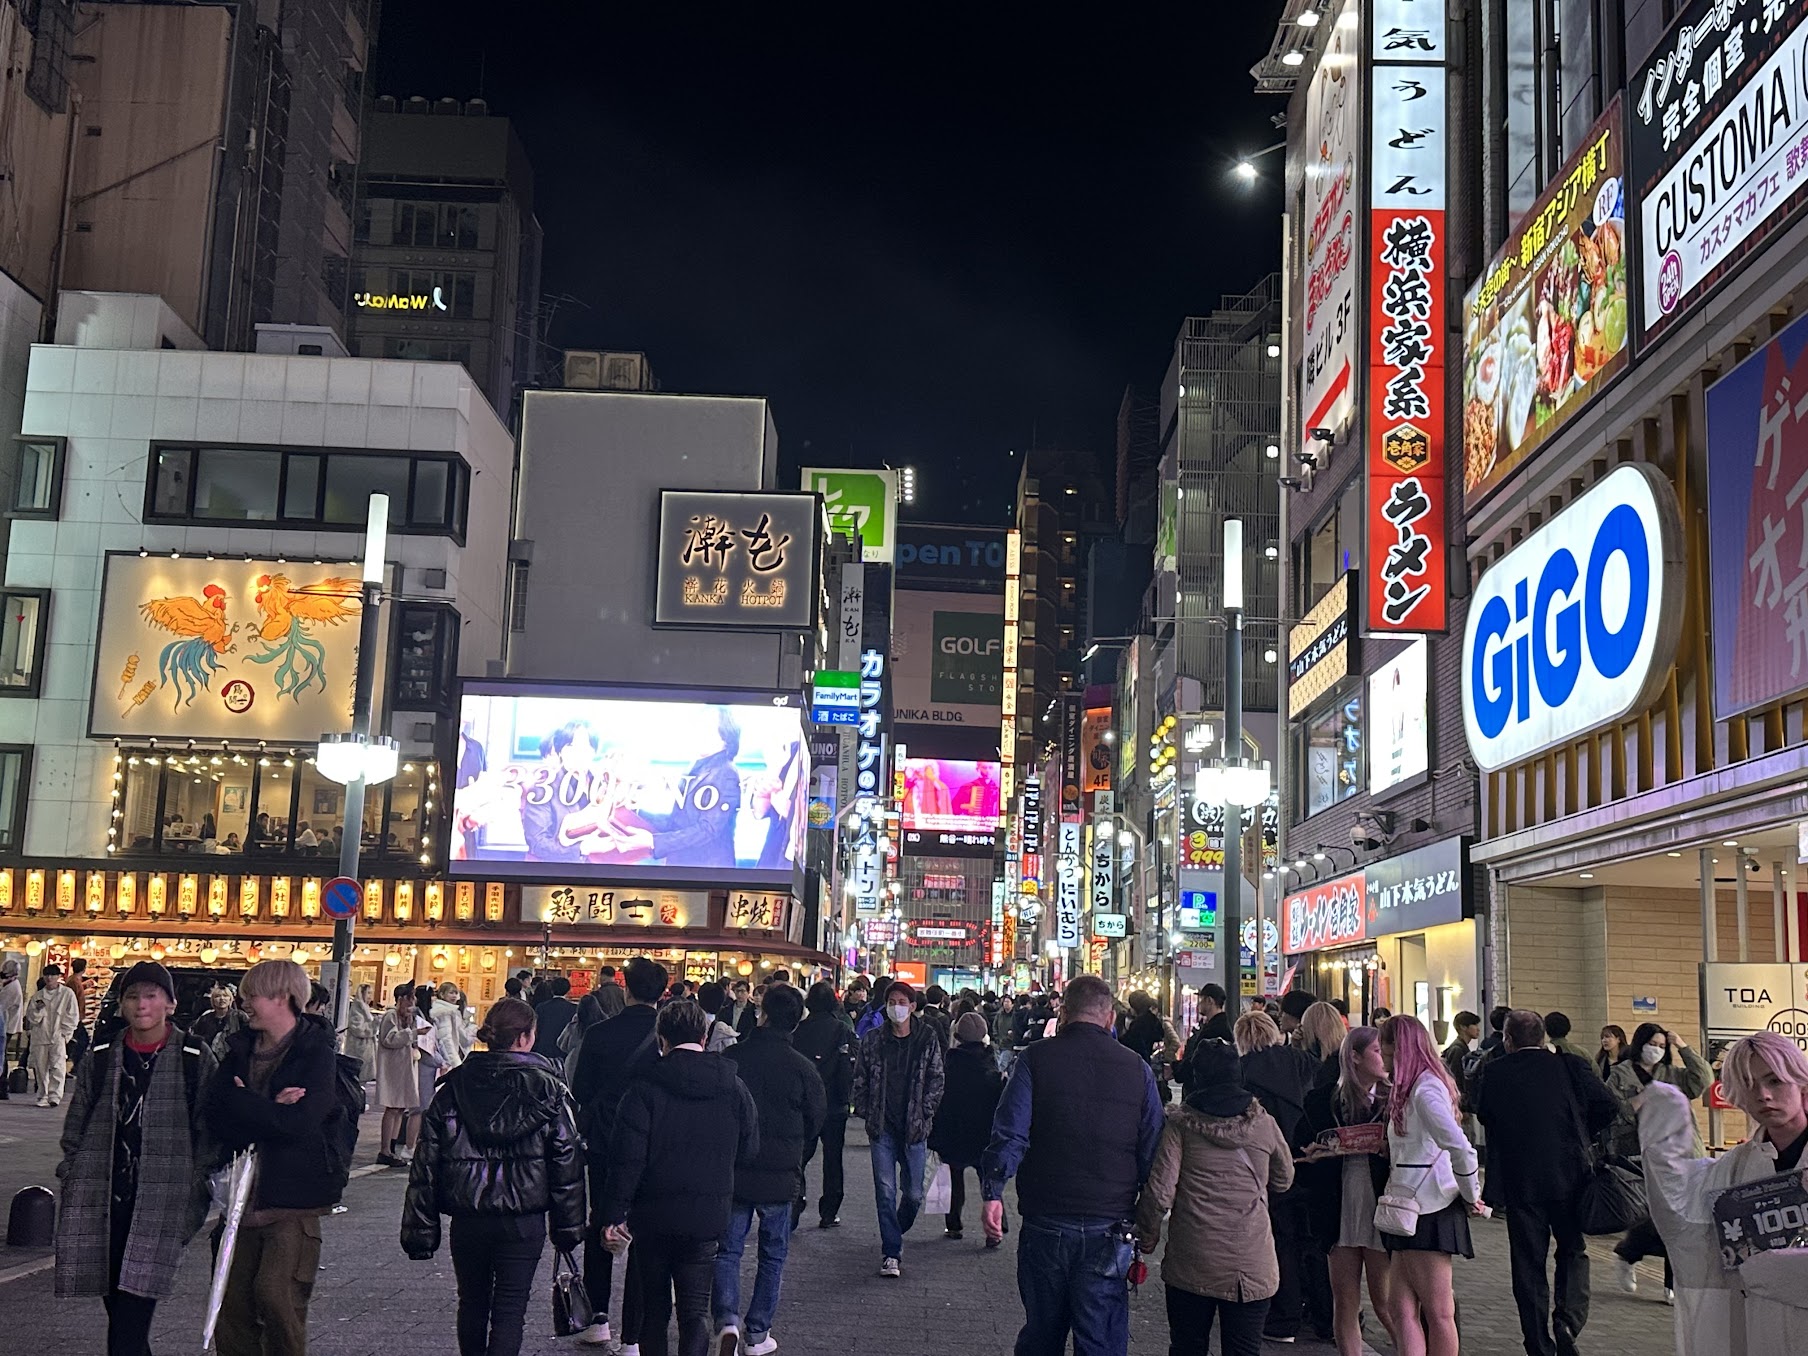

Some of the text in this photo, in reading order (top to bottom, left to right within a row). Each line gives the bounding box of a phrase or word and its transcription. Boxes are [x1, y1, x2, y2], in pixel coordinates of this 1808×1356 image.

[1656, 65, 1791, 257] CUSTOMA
[1521, 128, 1611, 270] 新宿アジア横丁
[1700, 172, 1779, 265] カスタマカフェ
[1662, 279, 1679, 307] OPEN
[1336, 288, 1352, 345] 3F
[1381, 217, 1434, 419] 横浜家系
[1387, 440, 1426, 457] 壱角家
[1382, 478, 1432, 624] ラーメン
[685, 594, 785, 605] KANKA HOTPOT
[1472, 503, 1650, 740] GiGO
[940, 636, 1000, 656] GOLF
[815, 692, 858, 702] FamilyMart
[818, 711, 855, 722] 酒 たばこ
[1093, 774, 1109, 787] 4F
[1095, 853, 1111, 907] ちから
[1380, 870, 1460, 909] 山下本気うどん
[549, 887, 654, 922] 鶏闘士
[731, 894, 771, 925] 串焼
[1061, 882, 1076, 939] にいむら
[1193, 893, 1205, 909] P
[1098, 920, 1124, 930] ちから
[1724, 989, 1772, 1003] TOA
